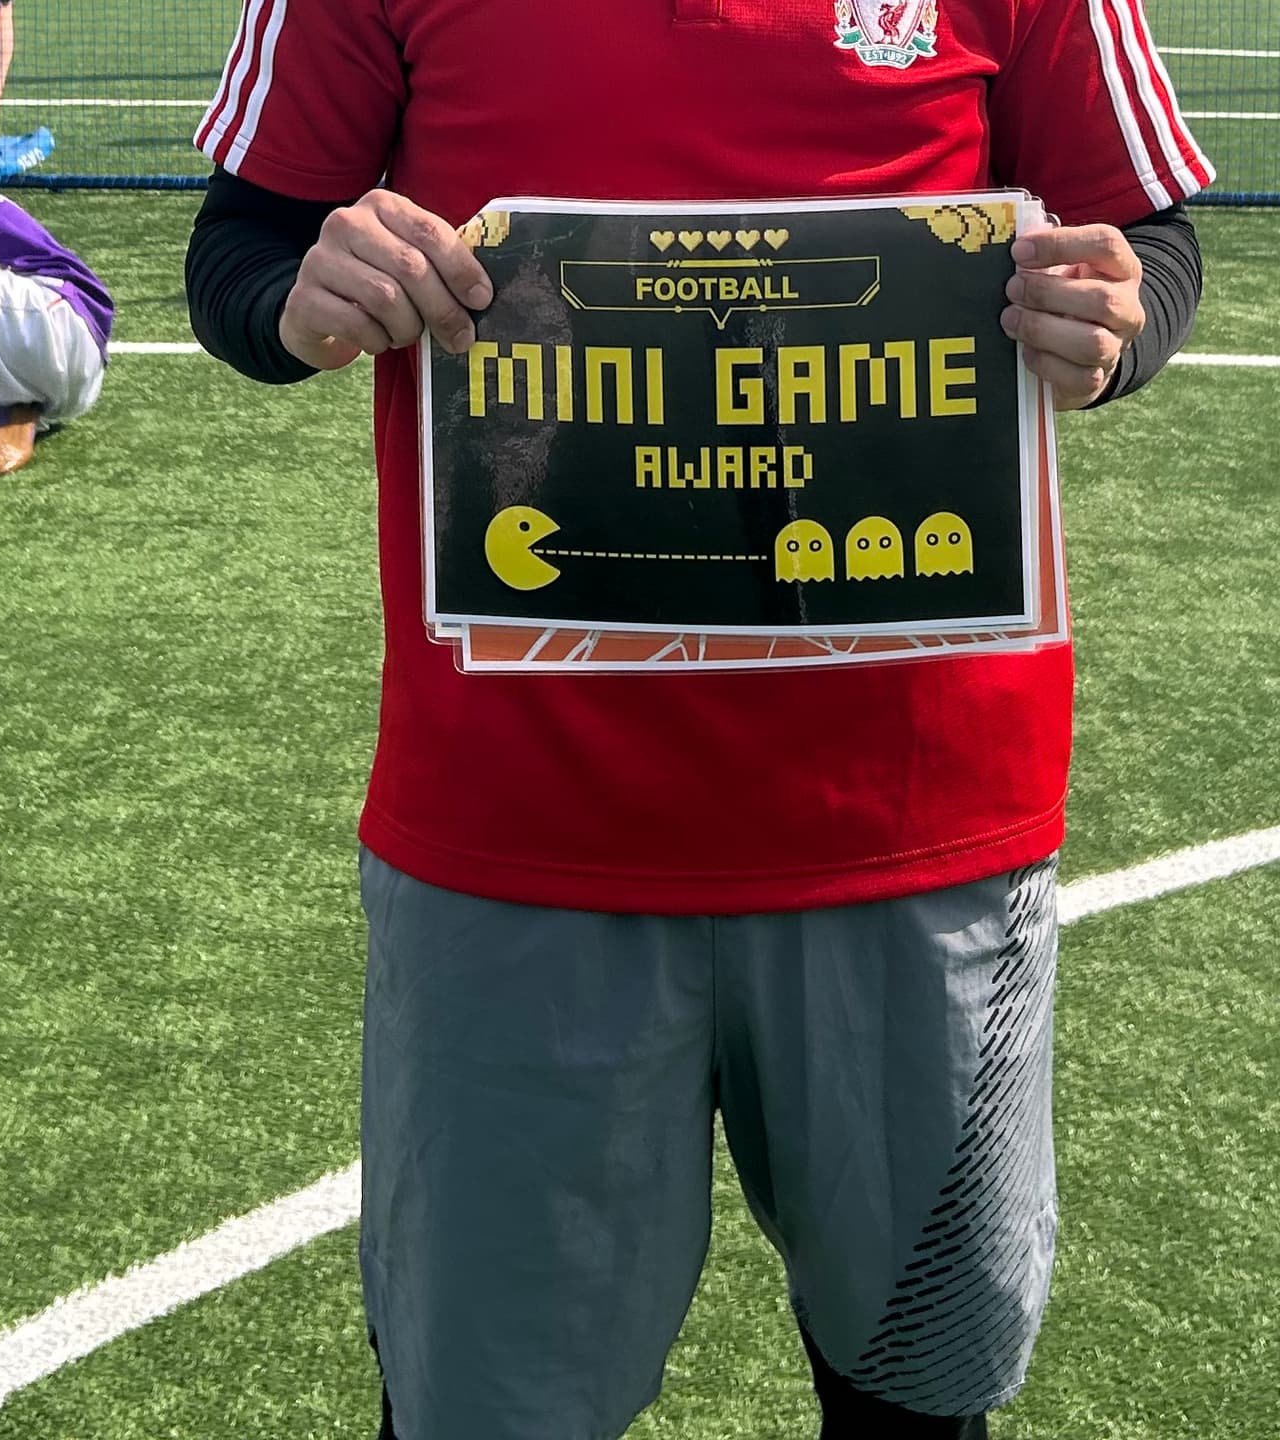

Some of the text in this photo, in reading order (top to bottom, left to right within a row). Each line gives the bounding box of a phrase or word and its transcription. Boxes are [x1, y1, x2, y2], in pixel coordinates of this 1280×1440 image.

[635, 276, 800, 302] FOOTBALL
[467, 336, 978, 427] MINI GAME
[634, 445, 815, 489] AWARD
